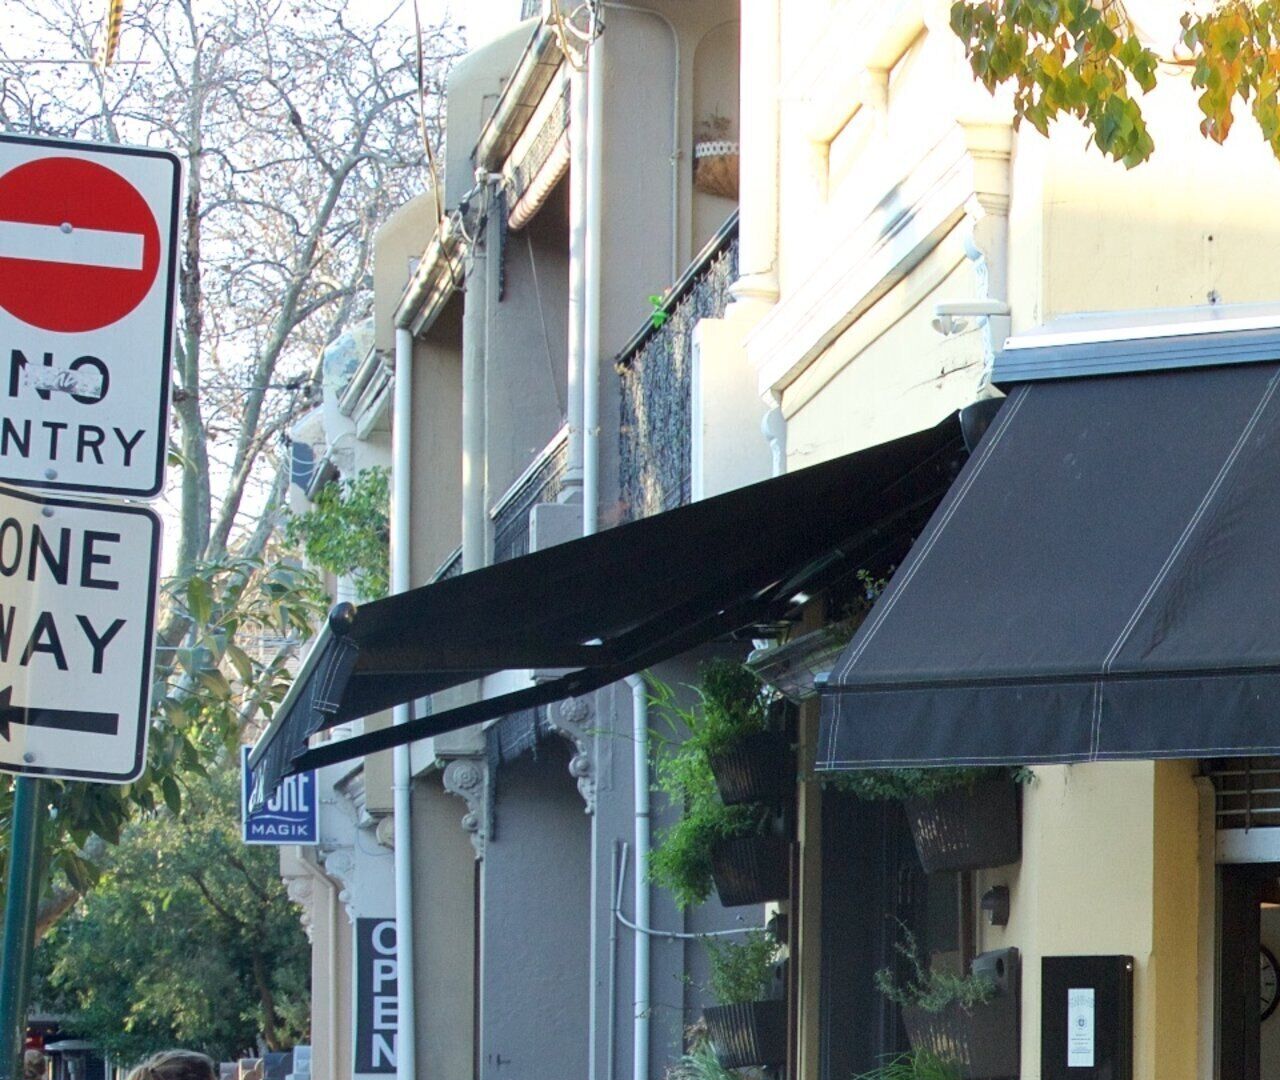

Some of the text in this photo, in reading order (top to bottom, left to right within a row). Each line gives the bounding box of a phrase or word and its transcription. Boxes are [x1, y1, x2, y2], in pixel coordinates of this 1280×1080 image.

[8, 348, 110, 405] NO
[0, 517, 121, 591] ONE
[251, 823, 309, 837] MAGIK
[371, 920, 399, 1068] OPEN
